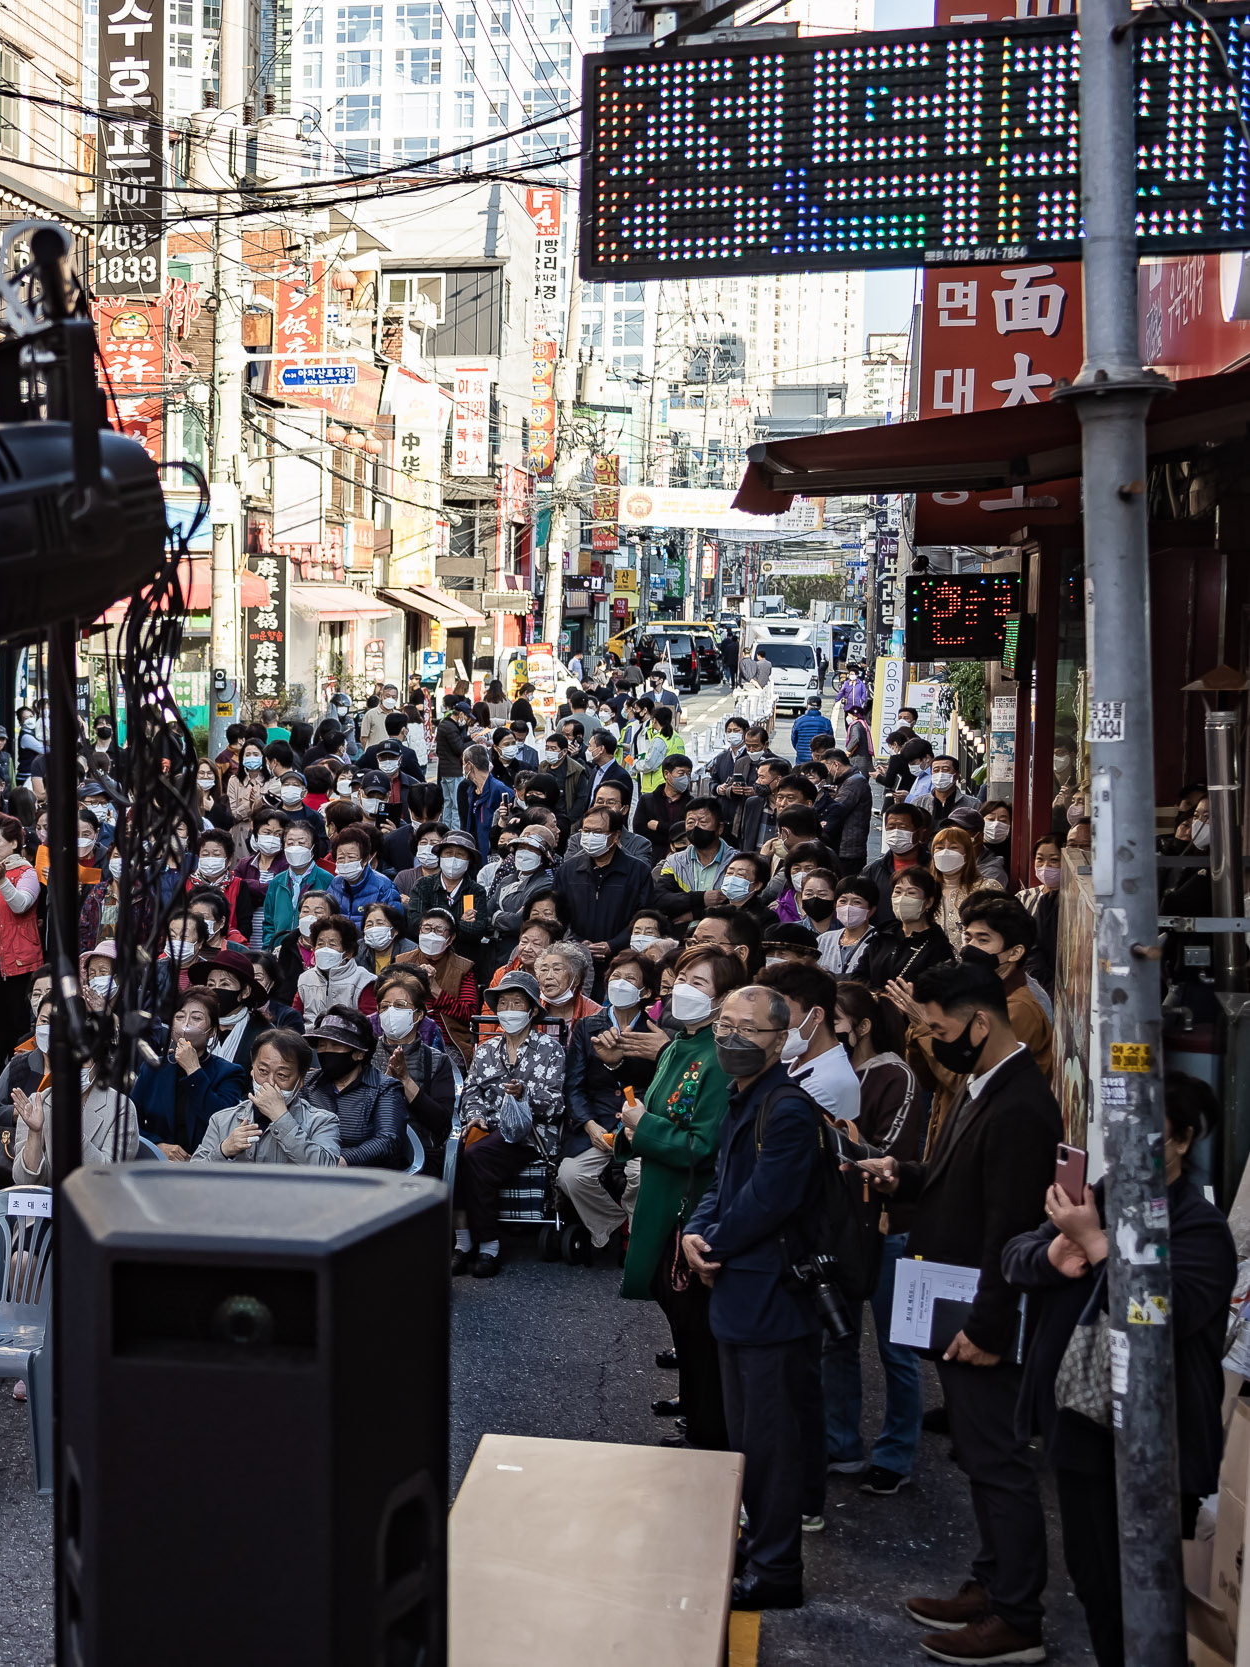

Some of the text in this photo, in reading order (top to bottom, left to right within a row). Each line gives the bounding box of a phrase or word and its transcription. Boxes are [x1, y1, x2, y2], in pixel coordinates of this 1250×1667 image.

[104, 176, 155, 205] HOF
[98, 256, 157, 283] 1833
[298, 368, 355, 378] 아차산로28길
[886, 661, 900, 693] cafe
[884, 697, 898, 708] in
[12, 1200, 49, 1211] 초대석
